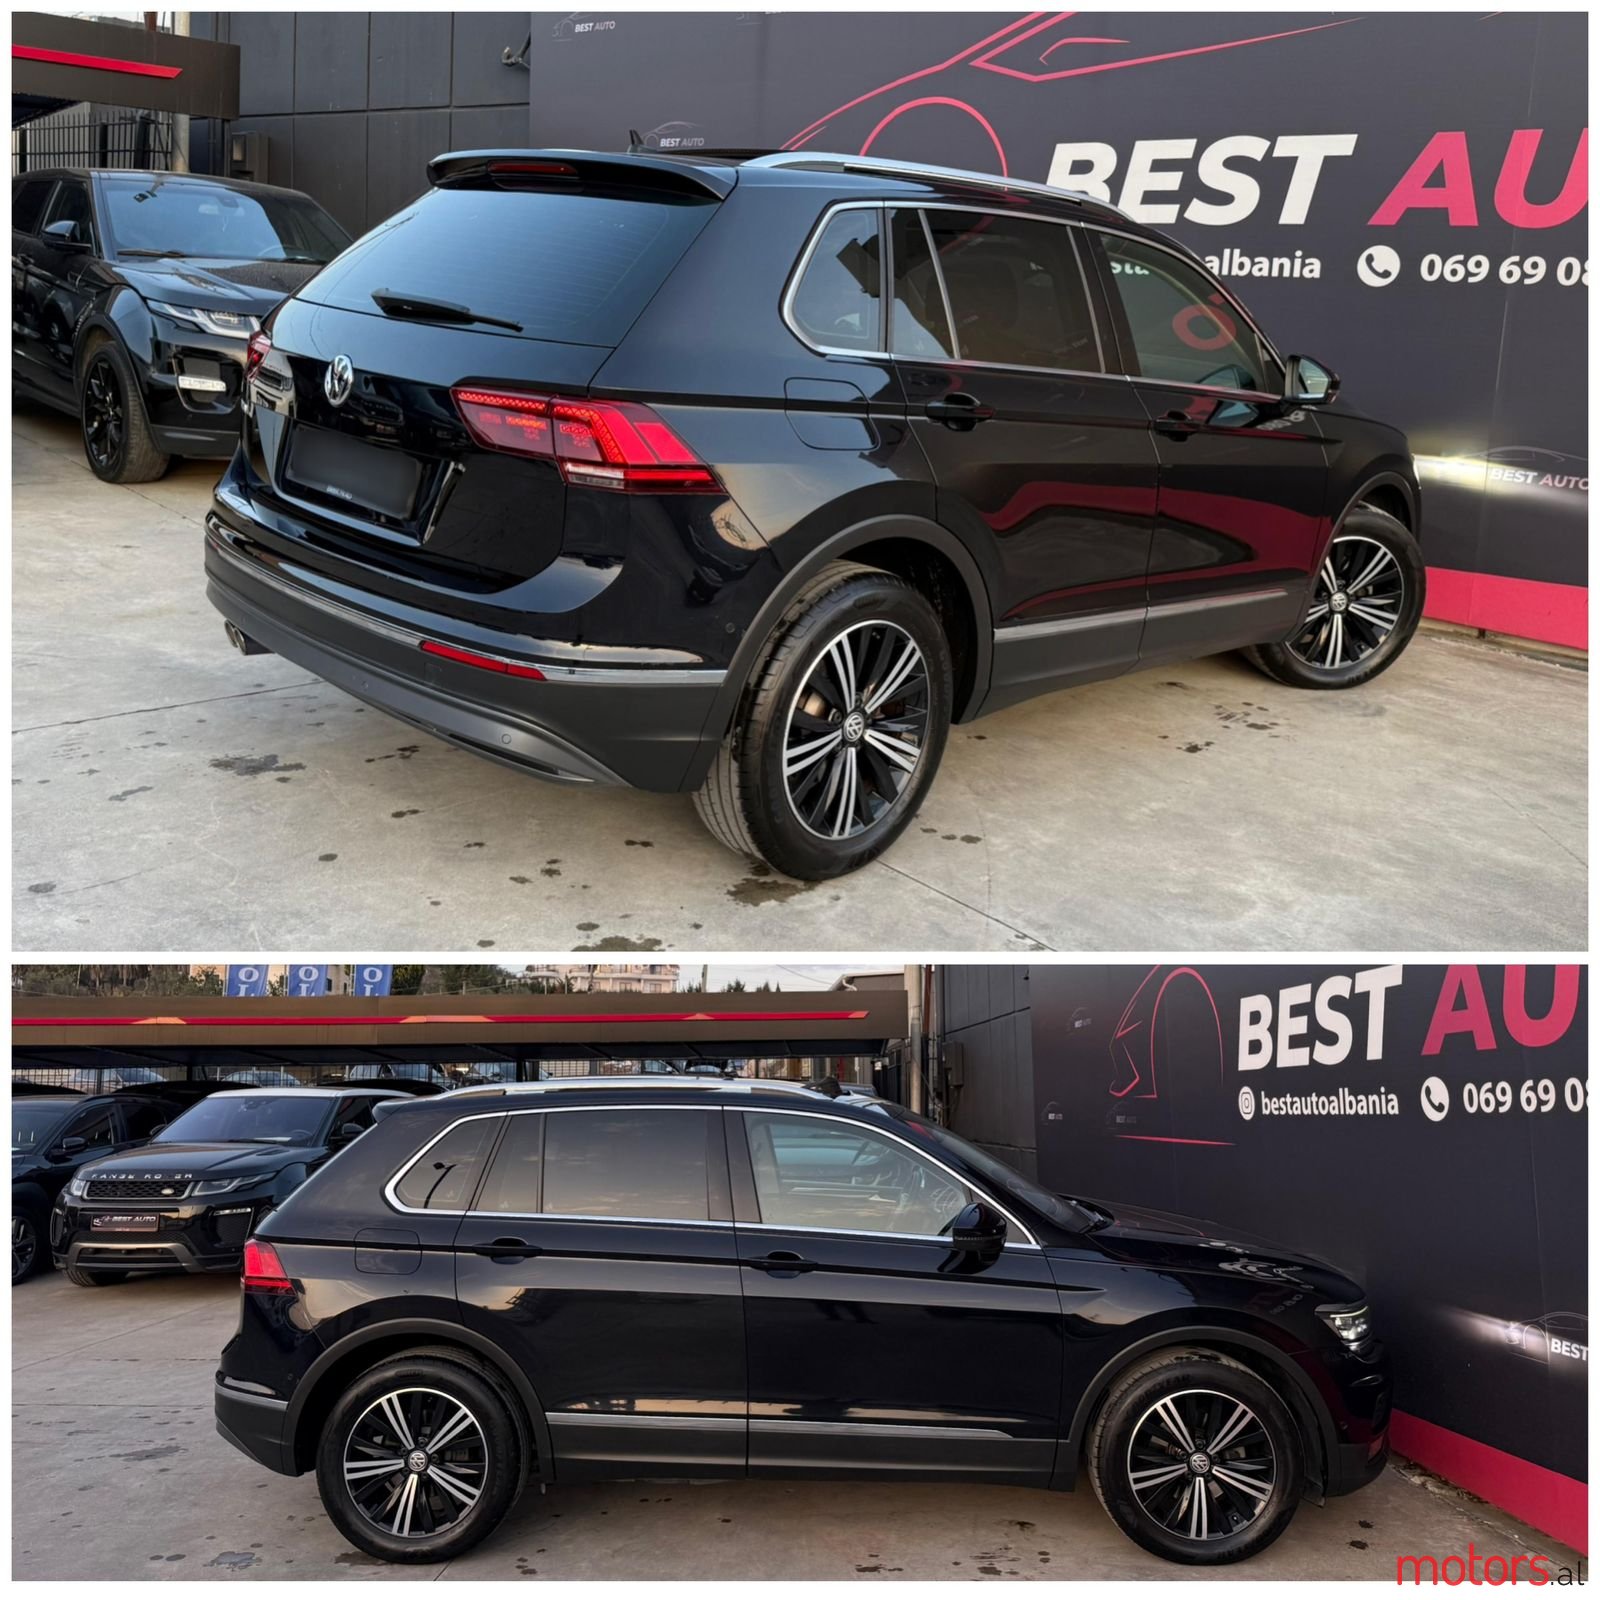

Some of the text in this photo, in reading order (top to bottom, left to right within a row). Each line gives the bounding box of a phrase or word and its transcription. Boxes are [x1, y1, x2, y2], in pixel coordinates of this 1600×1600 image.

[575, 20, 616, 33] BEST AUTO
[660, 137, 705, 148] BEST AUTO
[1046, 133, 1358, 226] BEST
[1420, 253, 1490, 284] 069
[1498, 255, 1547, 285] 69
[1489, 468, 1538, 485] BEST
[1238, 964, 1403, 1071] BEST
[1261, 1077, 1588, 1115] bestautoalbania 069 69 0
[1551, 1338, 1588, 1361] BEST
